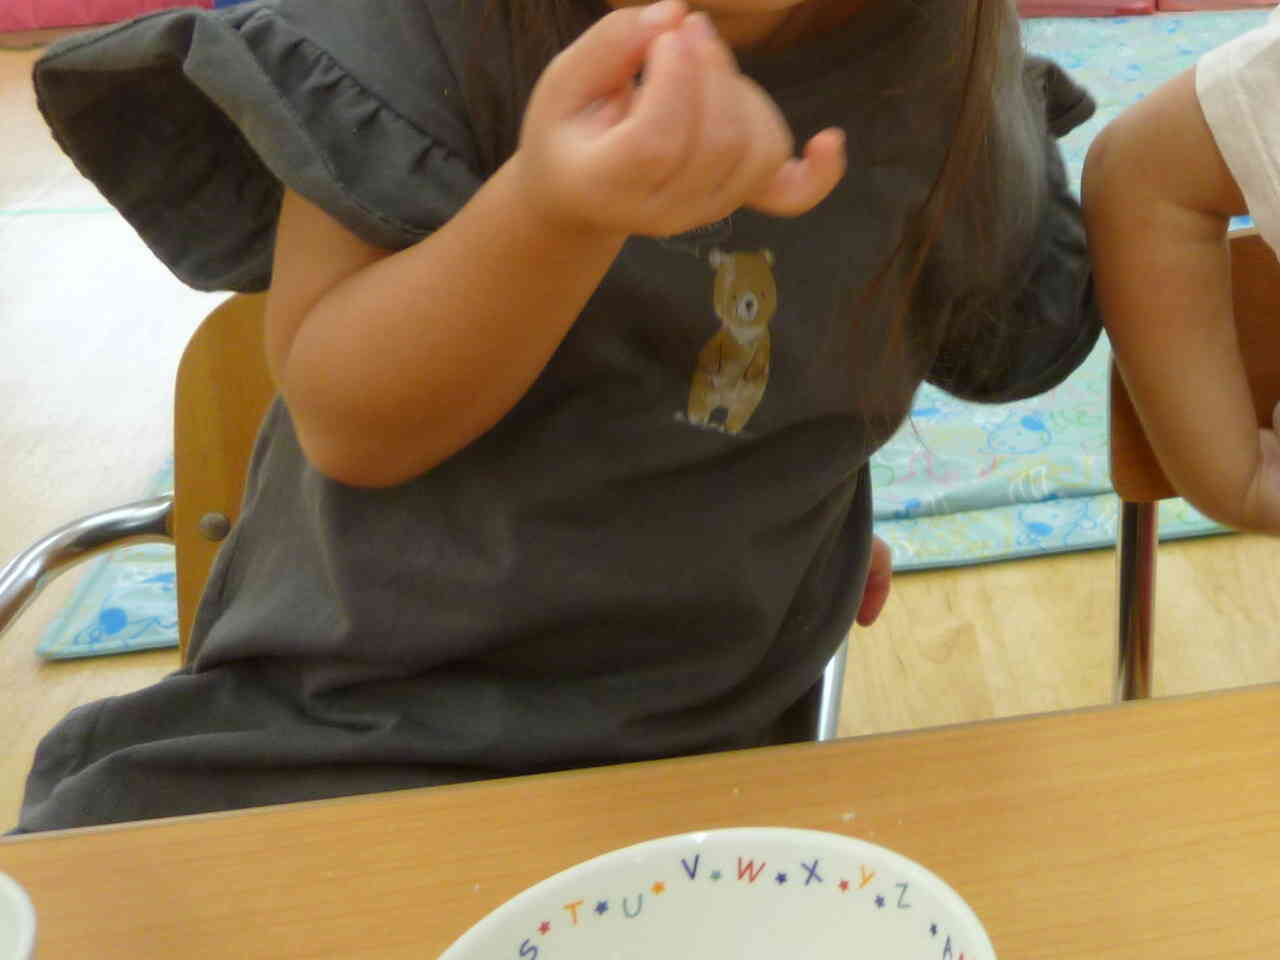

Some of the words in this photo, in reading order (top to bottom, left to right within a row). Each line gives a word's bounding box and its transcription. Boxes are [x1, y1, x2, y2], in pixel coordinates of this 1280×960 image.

[519, 938, 539, 960] S
[562, 900, 584, 926] T
[622, 893, 644, 918] U
[681, 854, 700, 881] V
[736, 856, 767, 884] W
[800, 859, 824, 887] X
[858, 863, 876, 889] Y
[895, 881, 912, 909] Z
